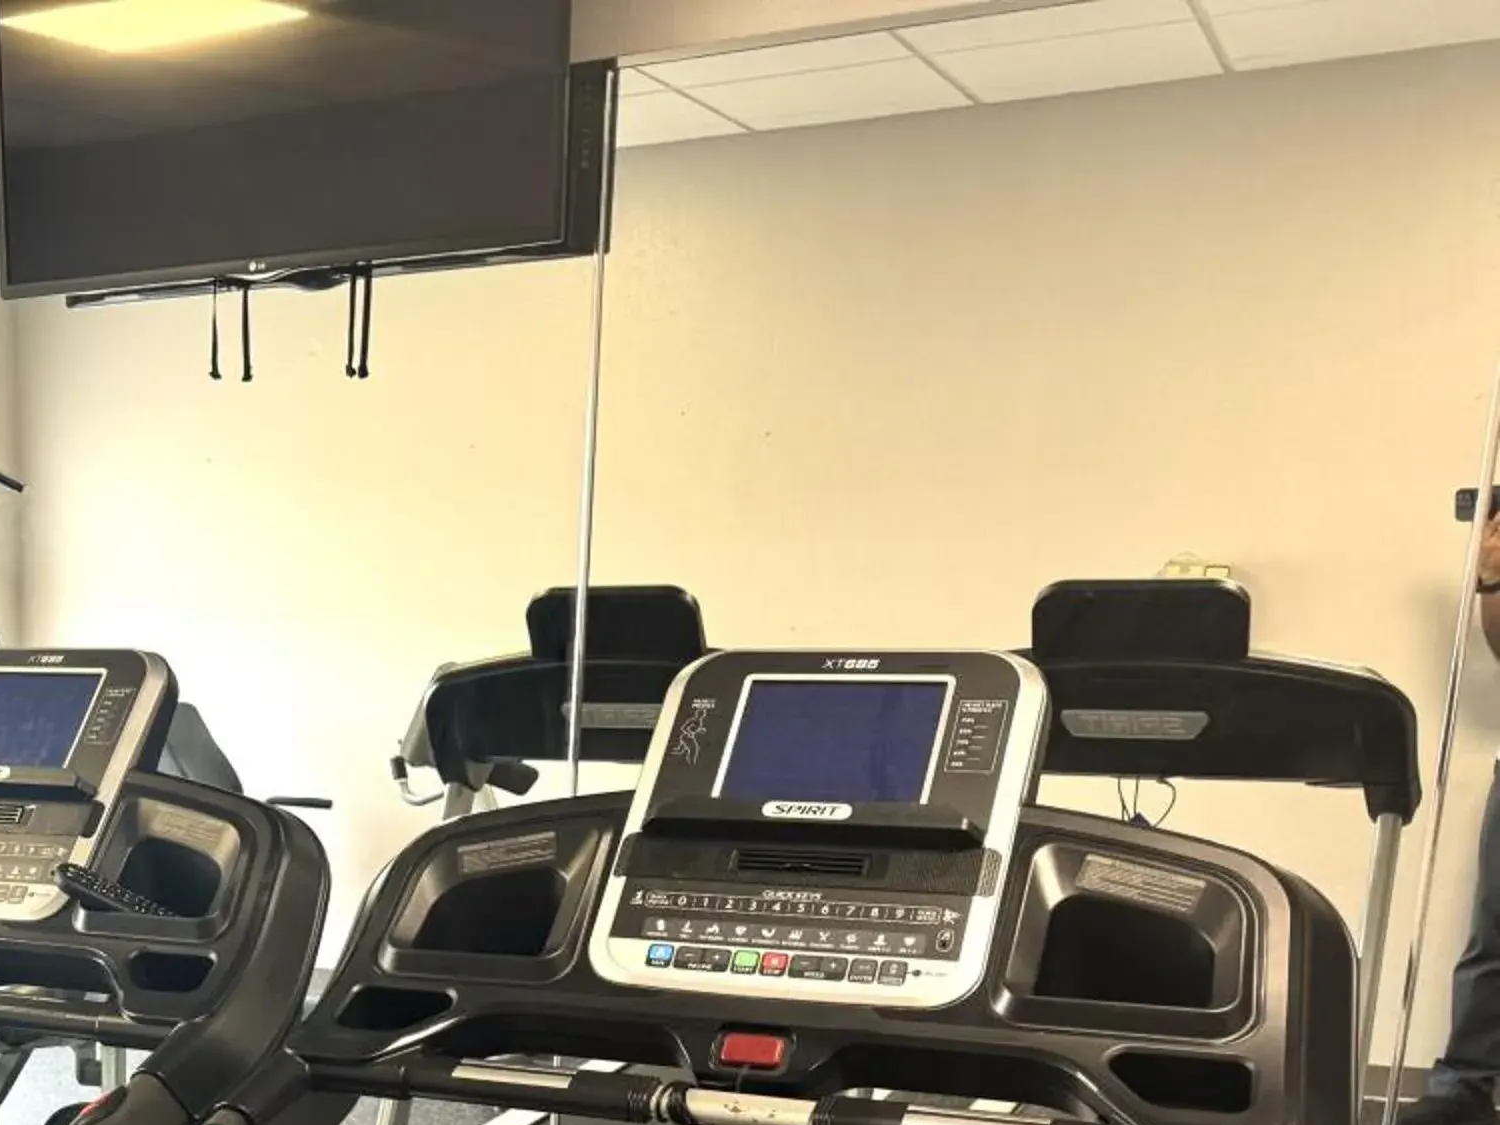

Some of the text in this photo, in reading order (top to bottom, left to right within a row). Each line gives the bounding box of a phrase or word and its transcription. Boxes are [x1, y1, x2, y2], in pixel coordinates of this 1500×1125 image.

[771, 803, 843, 817] SPIRIT
[677, 895, 687, 906] 0
[724, 898, 734, 909] 2
[747, 900, 757, 911] 3
[771, 901, 781, 911] 4
[796, 902, 805, 913] 5
[821, 905, 829, 915] 6
[846, 905, 856, 916] 7
[870, 907, 879, 917] 8
